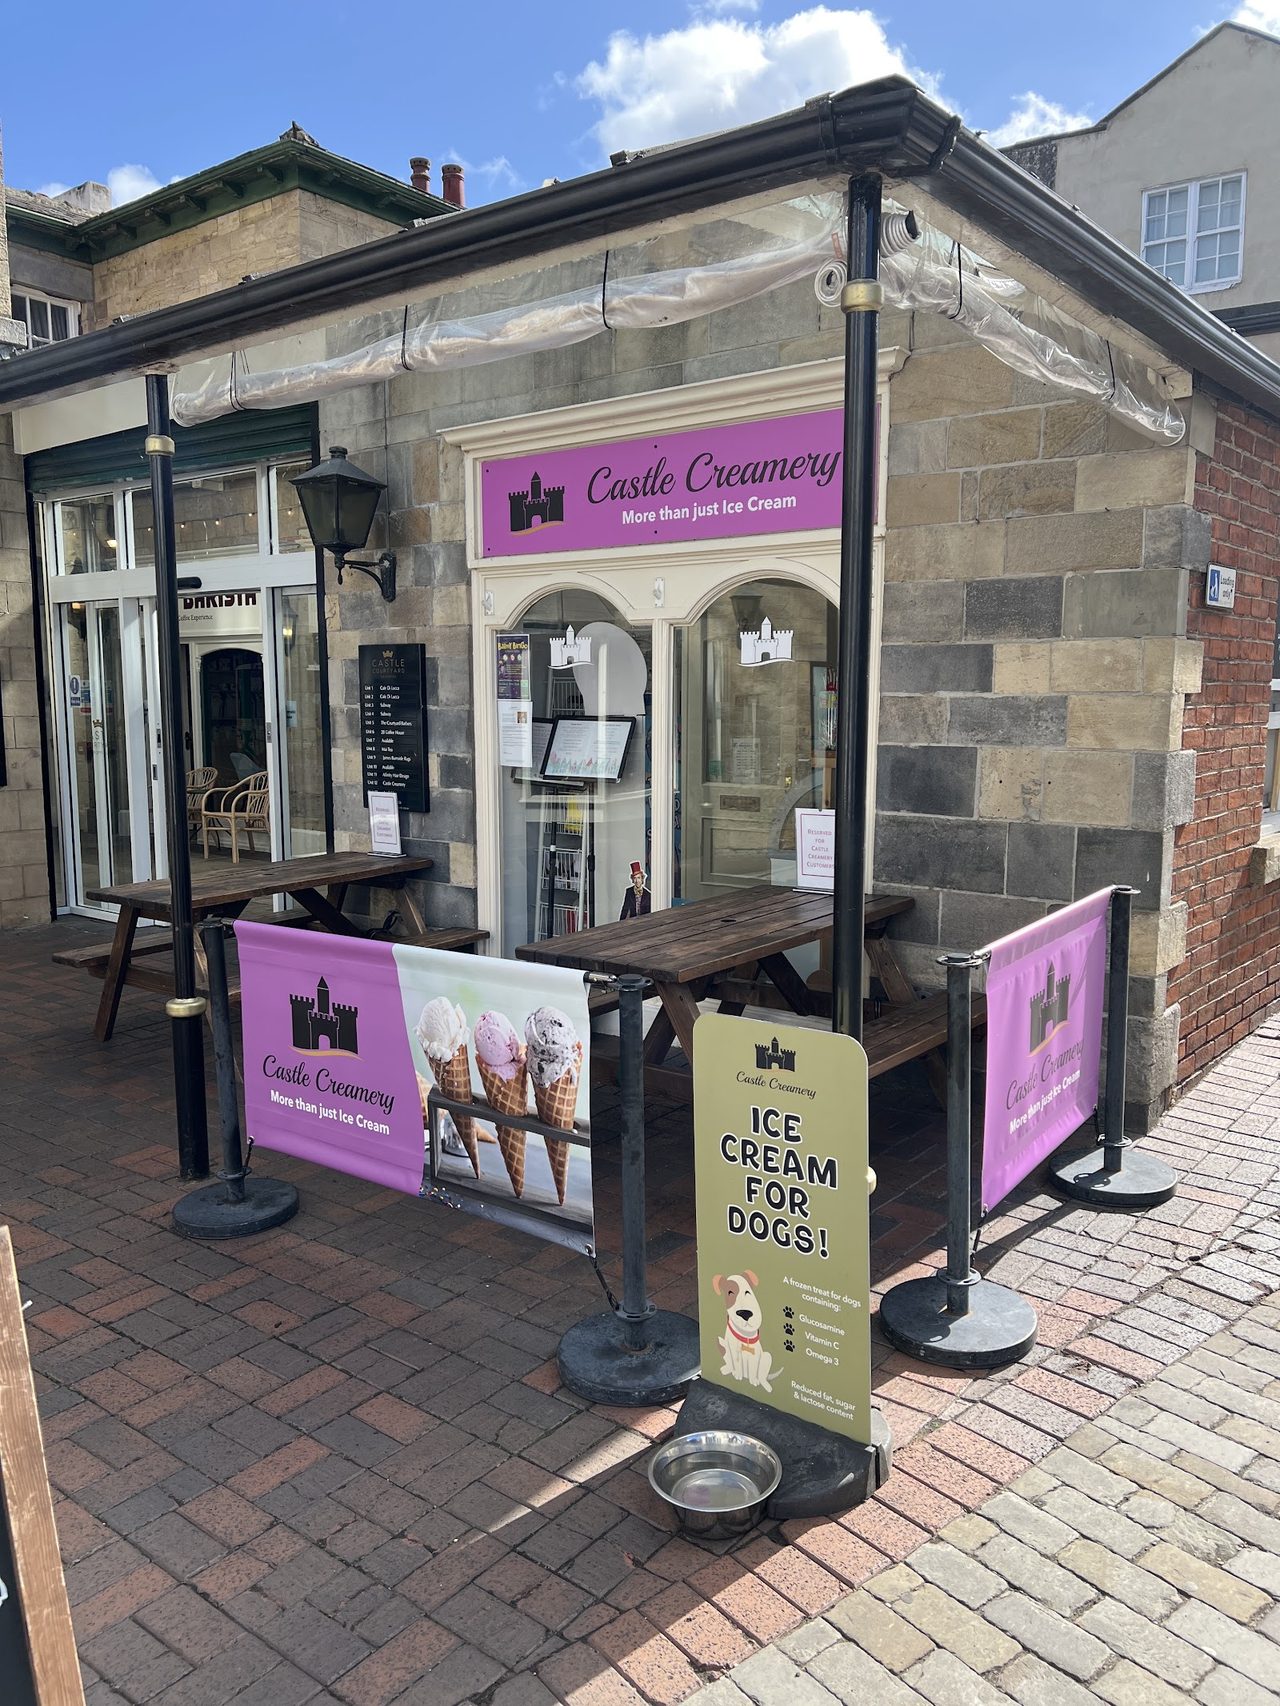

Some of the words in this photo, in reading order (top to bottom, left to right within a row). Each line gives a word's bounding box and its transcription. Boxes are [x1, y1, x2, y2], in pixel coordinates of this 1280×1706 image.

[587, 456, 676, 504] Castle
[685, 452, 842, 492] Creamery
[622, 510, 656, 524] More
[659, 505, 689, 520] than
[692, 501, 718, 521] just
[722, 499, 743, 514] Ice
[747, 496, 797, 511] Cream
[372, 659, 405, 667] CASTLE
[263, 1055, 311, 1087] Castle
[316, 1068, 395, 1115] Creamery
[736, 1070, 767, 1088] Castle
[769, 1077, 817, 1100] Creamery
[1006, 1063, 1038, 1110] Castle
[270, 1089, 294, 1108] More
[295, 1097, 318, 1114] than
[319, 1103, 337, 1120] just
[339, 1109, 354, 1125] Ice
[356, 1114, 390, 1135] Cream
[1009, 1113, 1028, 1135] More
[1028, 1101, 1041, 1120] than
[1041, 1089, 1053, 1112] just
[1062, 1069, 1081, 1090] Cream
[751, 1105, 802, 1142] ICE
[721, 1133, 838, 1189] CREAM
[746, 1176, 809, 1218] FOR
[728, 1205, 829, 1259] DOGS!
[783, 1276, 789, 1285] A
[790, 1277, 812, 1292] frozen
[813, 1285, 830, 1298] treat
[831, 1290, 841, 1301] for
[842, 1293, 862, 1308] dogs
[802, 1292, 841, 1313] containing:
[799, 1314, 845, 1336] Glucosamine
[805, 1331, 832, 1348] Vitamin
[833, 1341, 840, 1350] C
[806, 1348, 833, 1366] Omega
[833, 1358, 839, 1366] 3
[791, 1381, 822, 1399] Reduced
[835, 1398, 856, 1412] sugar
[793, 1391, 800, 1400] &
[800, 1393, 825, 1410] lactose
[826, 1403, 854, 1421] content
